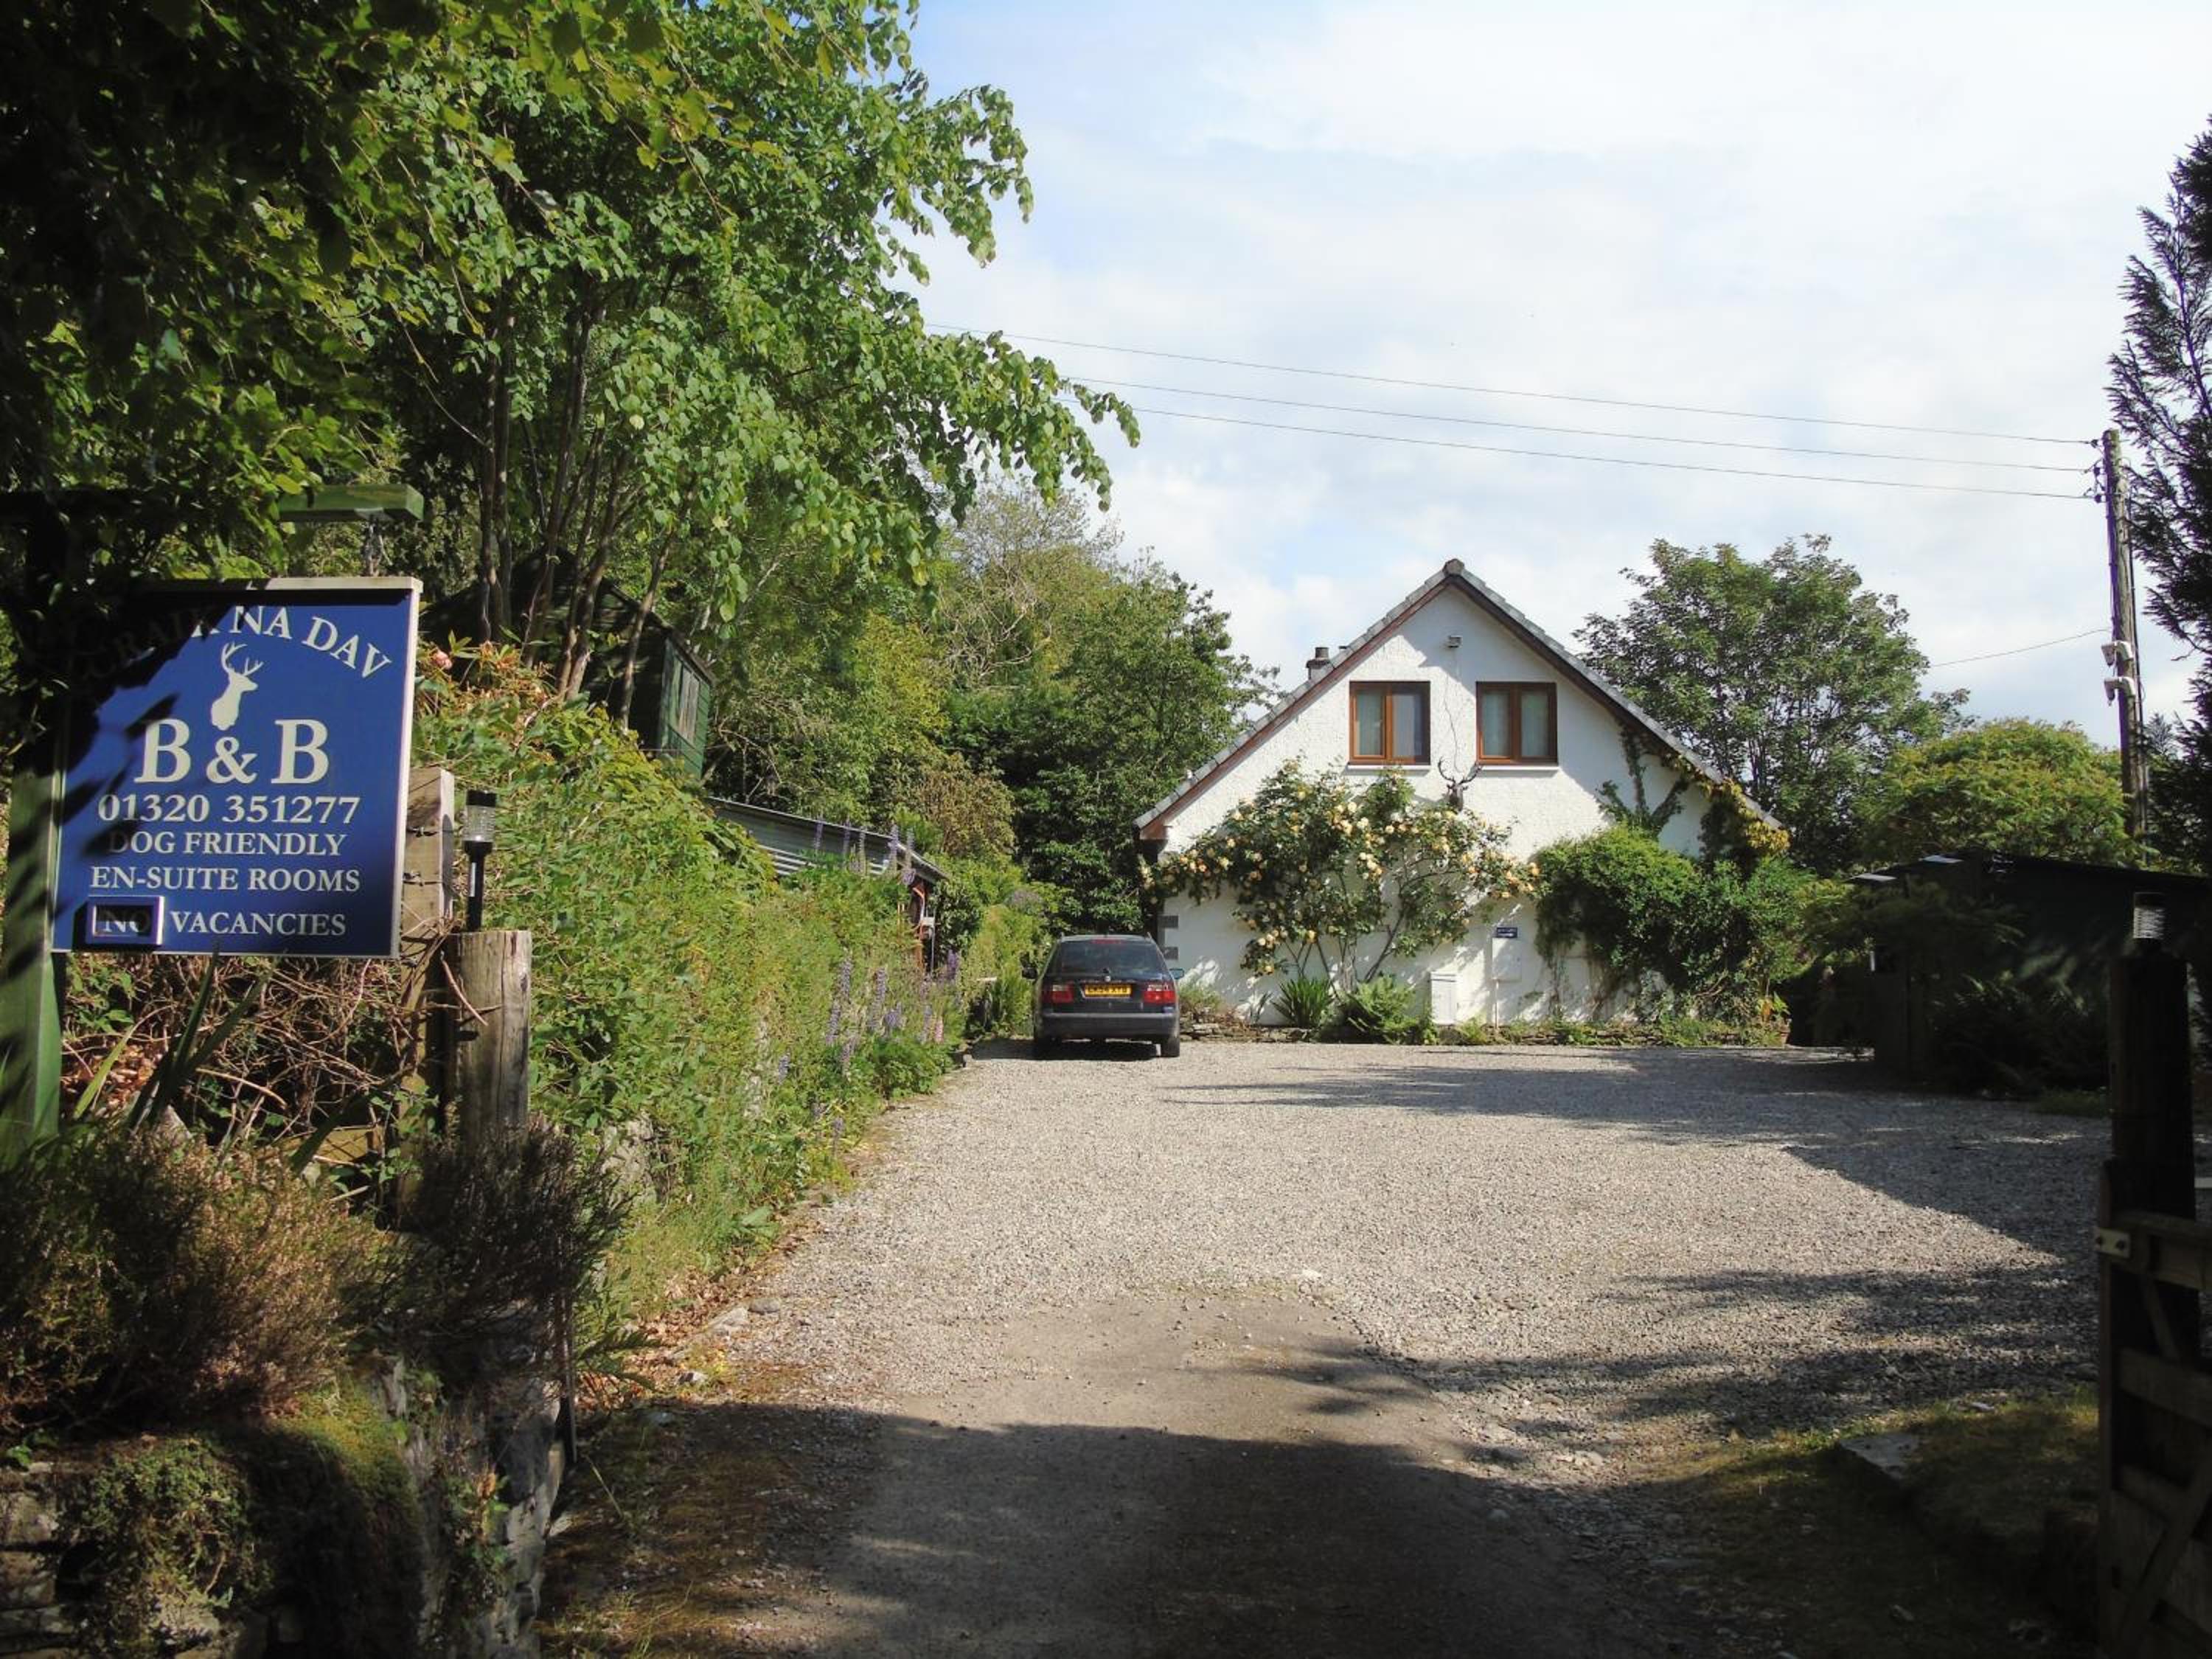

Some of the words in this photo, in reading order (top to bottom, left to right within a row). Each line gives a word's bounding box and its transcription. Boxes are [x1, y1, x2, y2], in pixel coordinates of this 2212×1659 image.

[302, 616, 392, 680] DAV
[133, 717, 192, 784] B
[206, 737, 258, 784] &
[271, 718, 330, 784] B
[97, 793, 210, 823] 01320
[222, 795, 361, 824] 351277
[108, 830, 175, 855] DOG
[183, 832, 348, 856] FRIENDLY
[90, 866, 240, 891] EN-SUITE
[247, 869, 361, 893] ROOMS
[170, 911, 347, 936] VACANCIES
